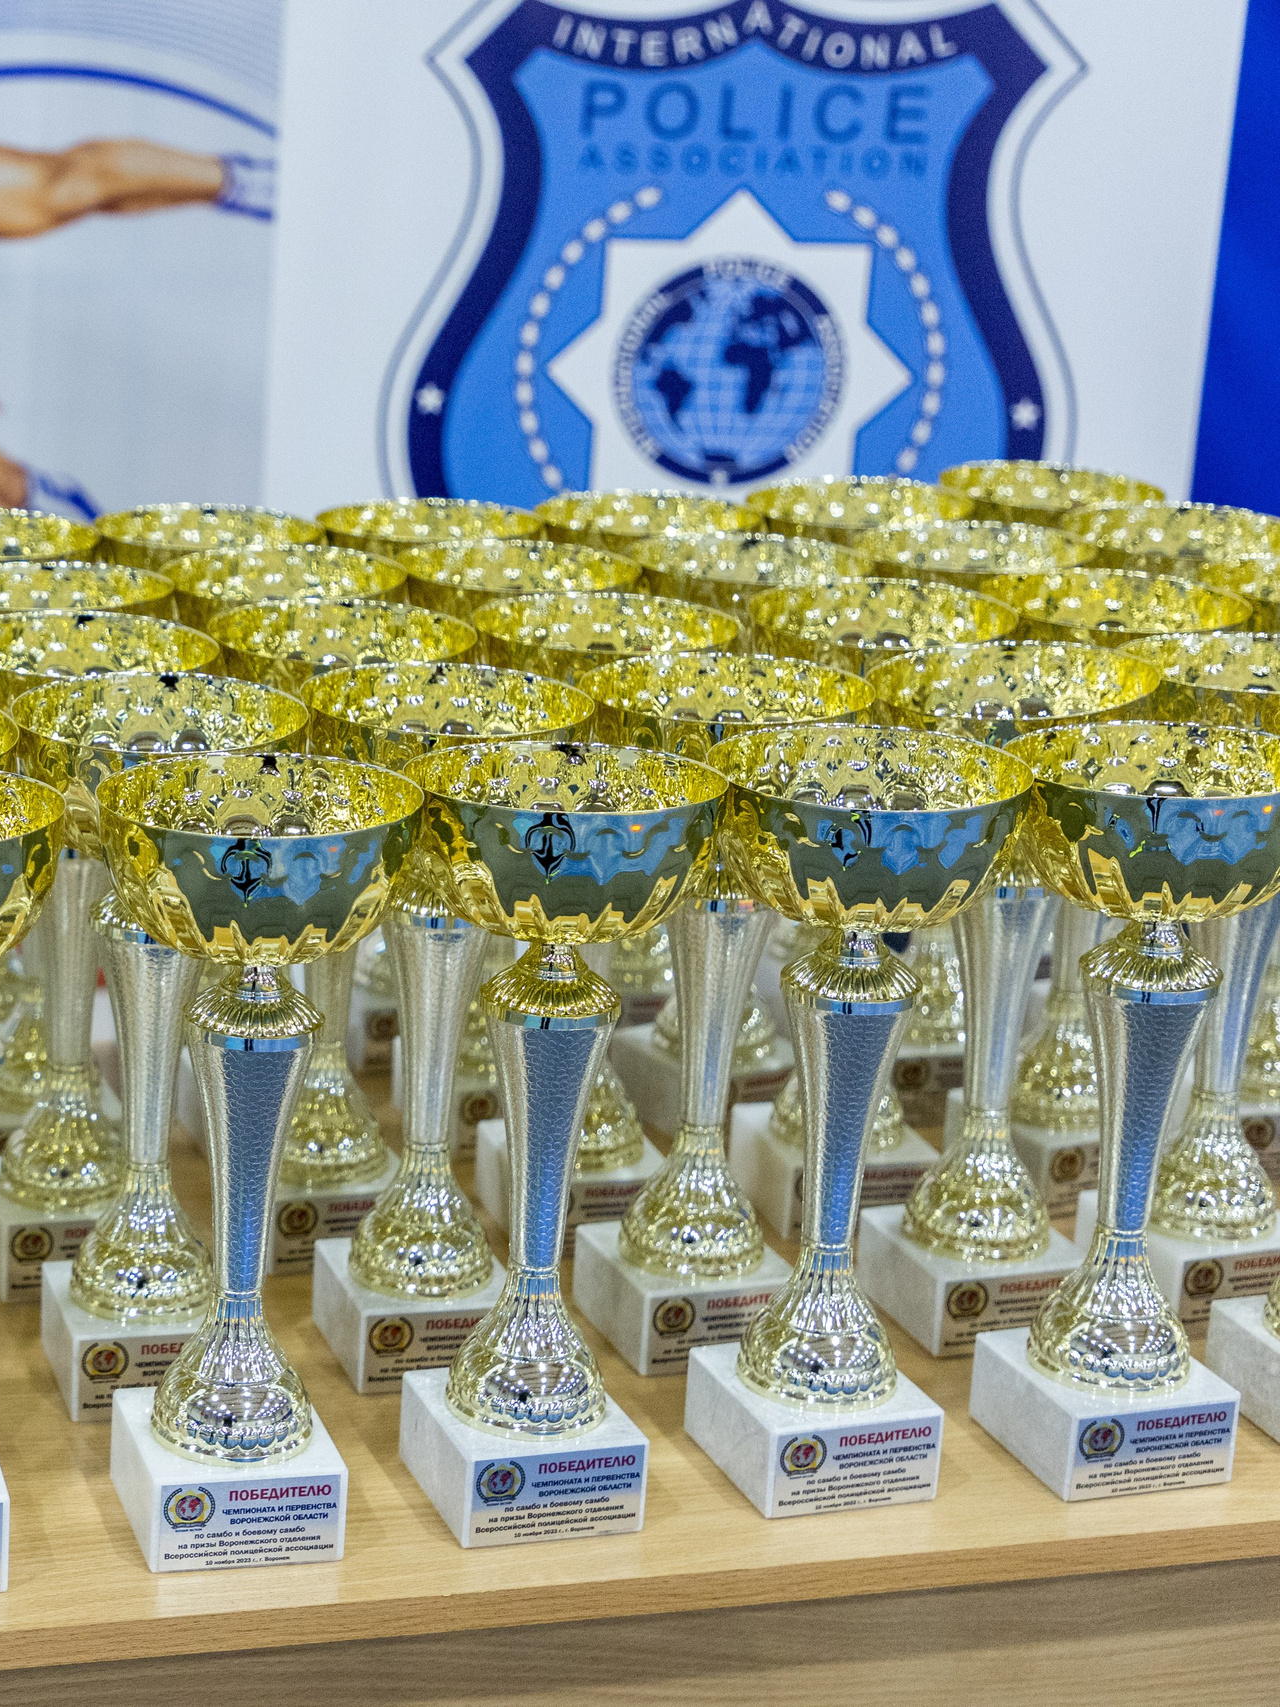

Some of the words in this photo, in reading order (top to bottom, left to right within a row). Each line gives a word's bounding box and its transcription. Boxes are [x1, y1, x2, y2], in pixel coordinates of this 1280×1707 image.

[552, 0, 958, 70] INTERNATIONAL
[578, 80, 931, 145] POLICE
[577, 142, 929, 180] ASSOCIATION
[1137, 1411, 1227, 1431] ПОБЕДИТЕЛЮ
[839, 1426, 932, 1447] ПОБЕДИТЕЛЮ
[1130, 1434, 1177, 1445] ЧЕМПИОНАТА
[1185, 1427, 1230, 1438] ПЕРВЕНСТВА
[832, 1450, 881, 1461] ЧЕМПИОНАТА
[889, 1443, 936, 1454] ПЕРВЕНСТВА
[1136, 1440, 1189, 1454] ВОРОНЕЖСКОЙ
[1190, 1437, 1222, 1447] ОБЛАСТИ
[538, 1455, 636, 1474] ПОБЕДИТЕЛЮ
[839, 1456, 894, 1470] ВОРОНЕЖСКОЙ
[895, 1453, 928, 1463] ОБЛАСТИ
[531, 1478, 582, 1488] ЧЕМПИОНАТА
[591, 1472, 640, 1483] ПЕРВЕНСТВА
[229, 1484, 332, 1502] ПОБЕДИТЕЛЮ
[538, 1485, 596, 1497] ВОРОНЕЖСКОЙ
[598, 1482, 632, 1491] ОБЛАСТИ
[222, 1506, 276, 1515] ЧЕМПИОНАТА
[285, 1502, 337, 1512] ПЕРВЕНСТВА
[516, 1503, 541, 1511] самбо
[549, 1500, 583, 1508] боевому
[585, 1496, 610, 1505] самбо
[230, 1514, 291, 1525] ВОРОНЕЖСКОЙ
[292, 1512, 328, 1521] ОБЛАСТИ
[500, 1515, 525, 1523] призы
[527, 1509, 583, 1519] Воронежского
[585, 1505, 624, 1513] отделения
[206, 1530, 233, 1538] самбо
[279, 1525, 306, 1534] самбо
[475, 1521, 536, 1534] Всероссийской
[537, 1516, 588, 1527] полицейской
[589, 1513, 636, 1522] ассоциации
[190, 1542, 217, 1550] призы
[219, 1538, 278, 1547] Воронежского
[279, 1535, 321, 1543] отделения
[164, 1549, 228, 1560] Всероссийской
[230, 1545, 283, 1555] полицейской
[285, 1544, 334, 1552] ассоциации
